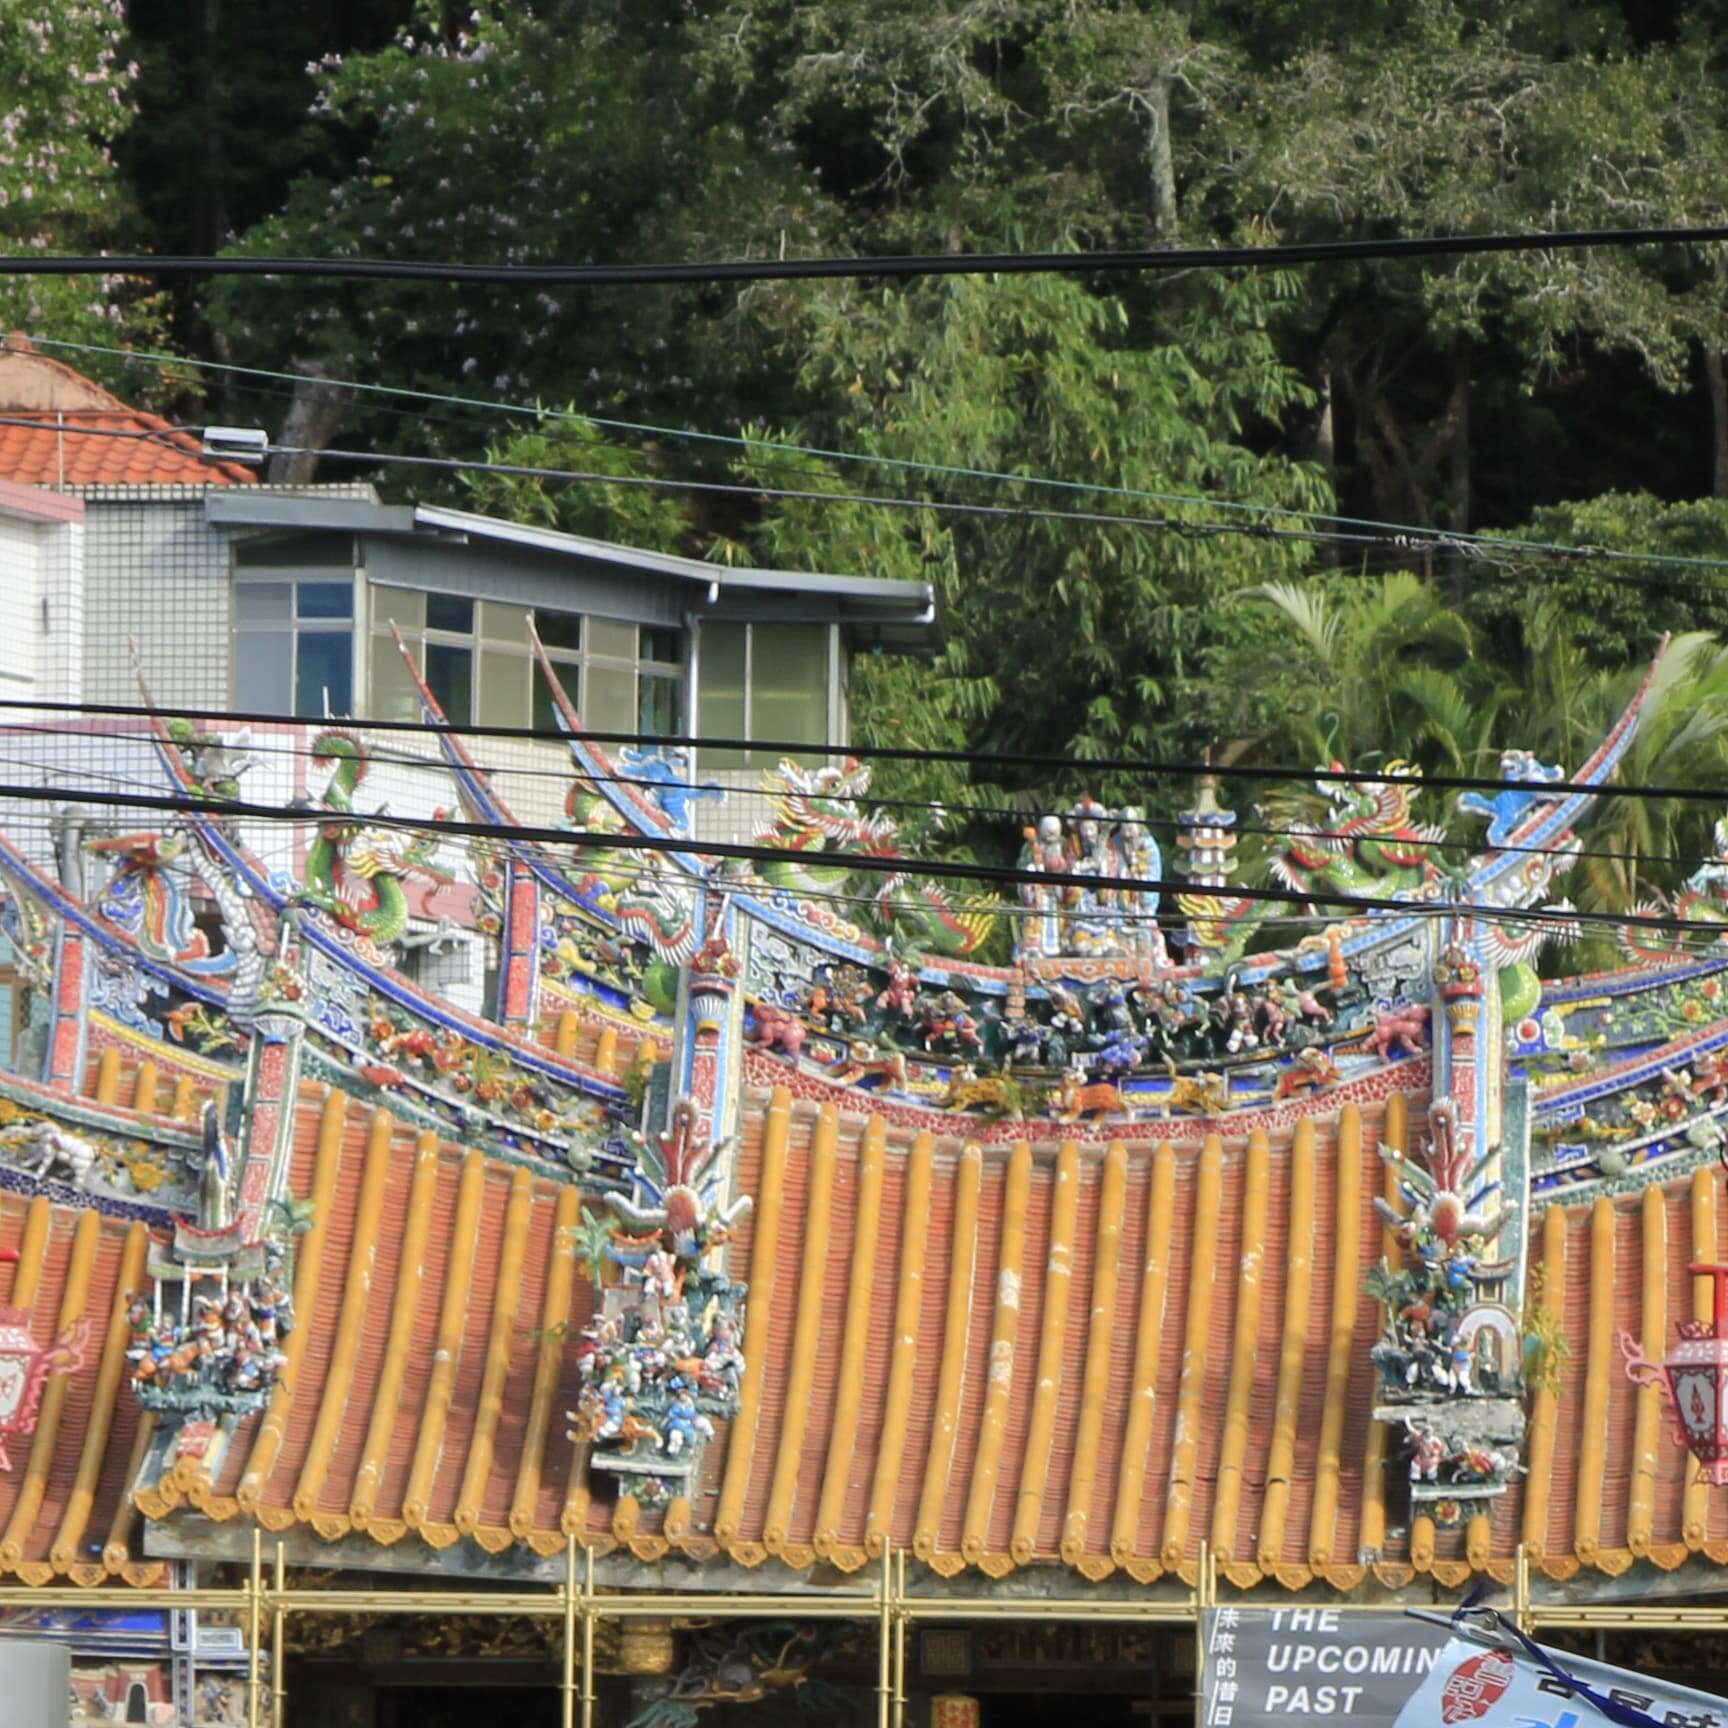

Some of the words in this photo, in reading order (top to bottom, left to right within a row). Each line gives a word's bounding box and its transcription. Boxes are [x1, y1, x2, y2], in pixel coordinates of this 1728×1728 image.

[1271, 1609, 1342, 1632] THE
[1212, 1608, 1241, 1727] 未來的昔日
[1265, 1687, 1363, 1714] PAST
